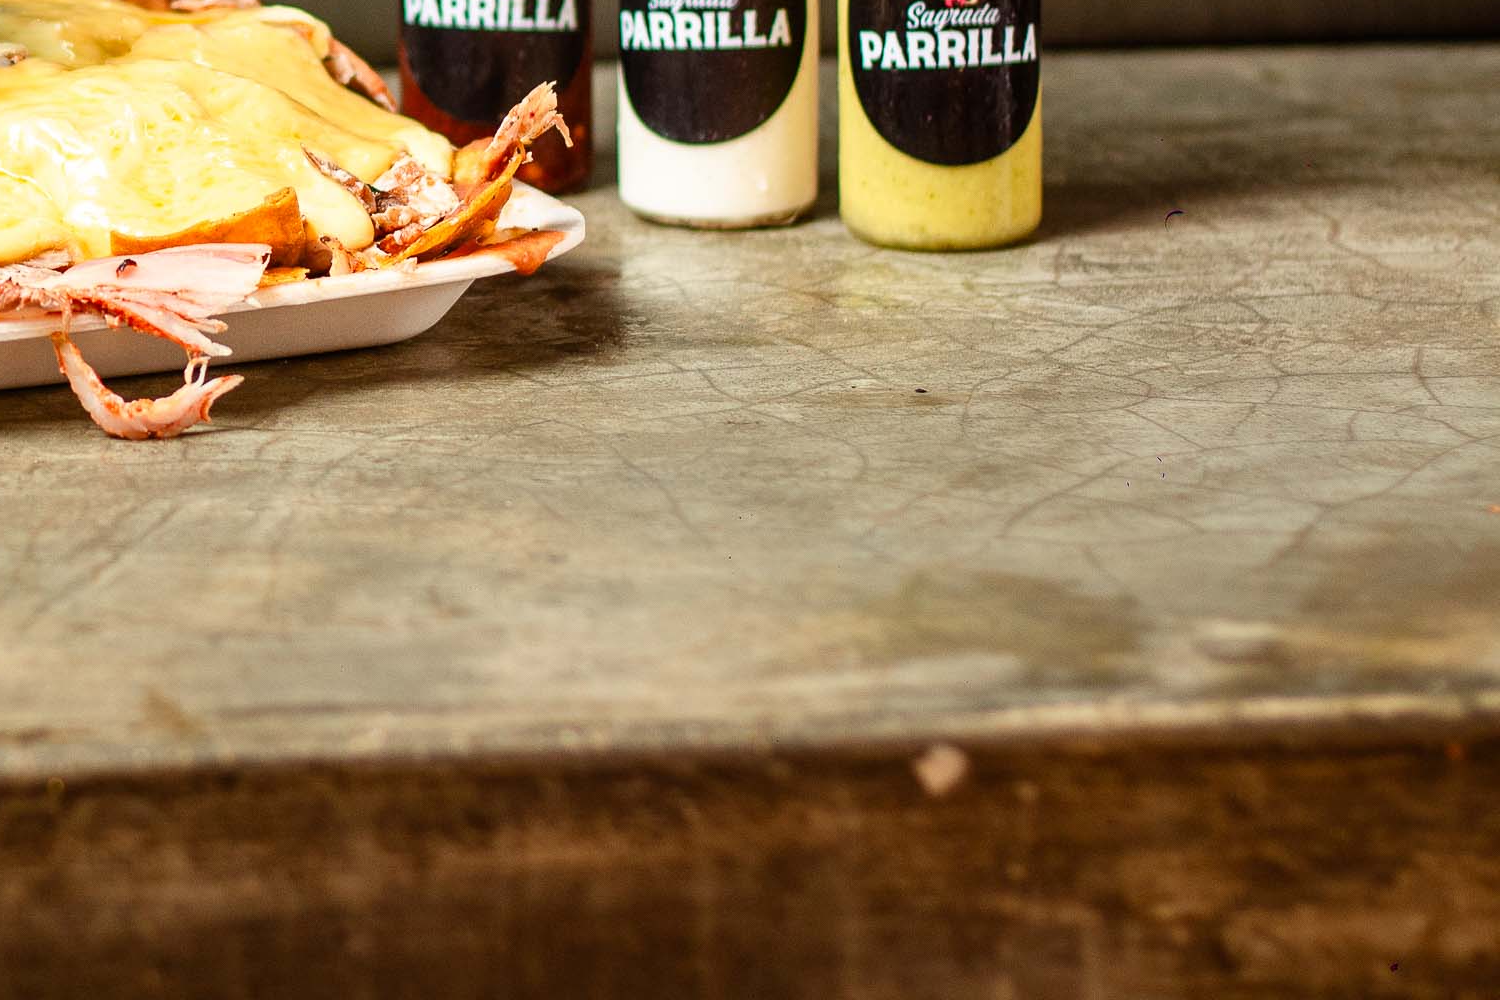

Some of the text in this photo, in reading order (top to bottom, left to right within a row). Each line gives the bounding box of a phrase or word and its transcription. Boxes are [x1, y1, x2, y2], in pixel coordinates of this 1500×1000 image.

[620, 8, 792, 50] PARRILLA
[907, 1, 1000, 32] Sagrada
[859, 23, 1037, 70] PARRILLA
